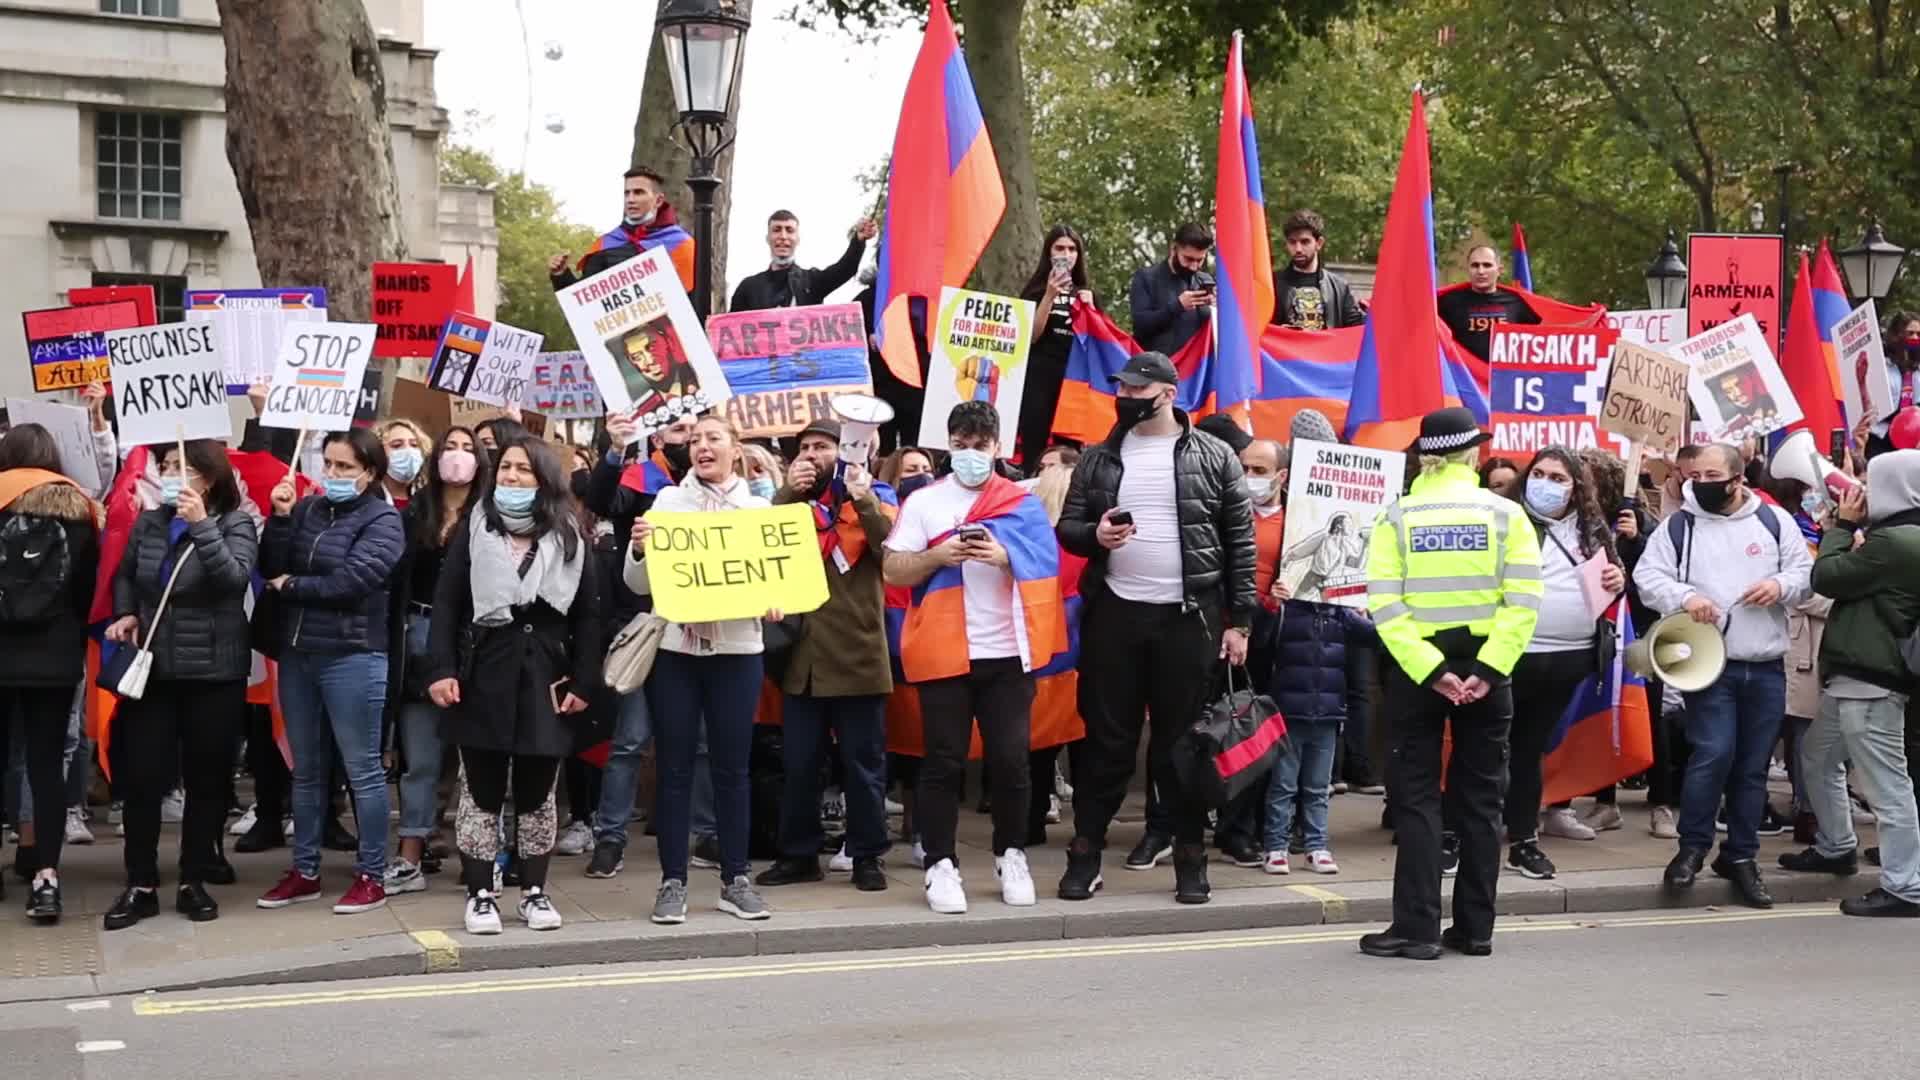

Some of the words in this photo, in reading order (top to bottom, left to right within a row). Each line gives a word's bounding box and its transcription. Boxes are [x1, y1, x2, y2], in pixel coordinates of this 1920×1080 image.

[375, 274, 432, 294] HANDS
[572, 257, 658, 306] TERRORISM
[1691, 284, 1775, 299] ARMENIA
[375, 299, 403, 317] OFF
[601, 288, 633, 313] HAS
[633, 283, 646, 299] A
[964, 297, 1012, 323] PEACE
[594, 308, 628, 335] NEW
[629, 292, 666, 319] FACE
[377, 323, 442, 341] ARTSAK
[493, 327, 537, 357] WITH
[949, 333, 970, 347] AND
[971, 337, 1016, 354] ARTSAKH
[953, 319, 973, 331] FOR
[974, 322, 1017, 339] ARMENIA
[1681, 322, 1746, 357] TERRORISM
[108, 325, 215, 367] RECOGNISE
[286, 334, 362, 369] STOP
[1492, 332, 1597, 366] ARTSAKH
[1701, 343, 1726, 361] HAS
[1726, 340, 1736, 351] A
[489, 356, 521, 376] OUR
[767, 347, 822, 380] IS
[1613, 348, 1689, 403] ARTSAKH
[122, 369, 228, 417] ARTSAKH
[267, 385, 356, 417] GENOCIDE
[534, 392, 596, 413] WAR
[1514, 376, 1545, 412] IS
[725, 391, 834, 430] ARMEN
[1606, 392, 1672, 436] STRONG
[1492, 420, 1598, 453] ARMENIA
[1316, 450, 1382, 471] SANCTION
[1309, 465, 1386, 488] AZERBAIJAN
[1306, 481, 1333, 498] AND
[1335, 486, 1385, 505] TURKEY
[652, 525, 733, 551] DONT
[760, 521, 802, 548] BE
[1411, 525, 1486, 535] METROPOLITAN
[1411, 533, 1488, 550] POLICE
[671, 555, 792, 588] SILENT
